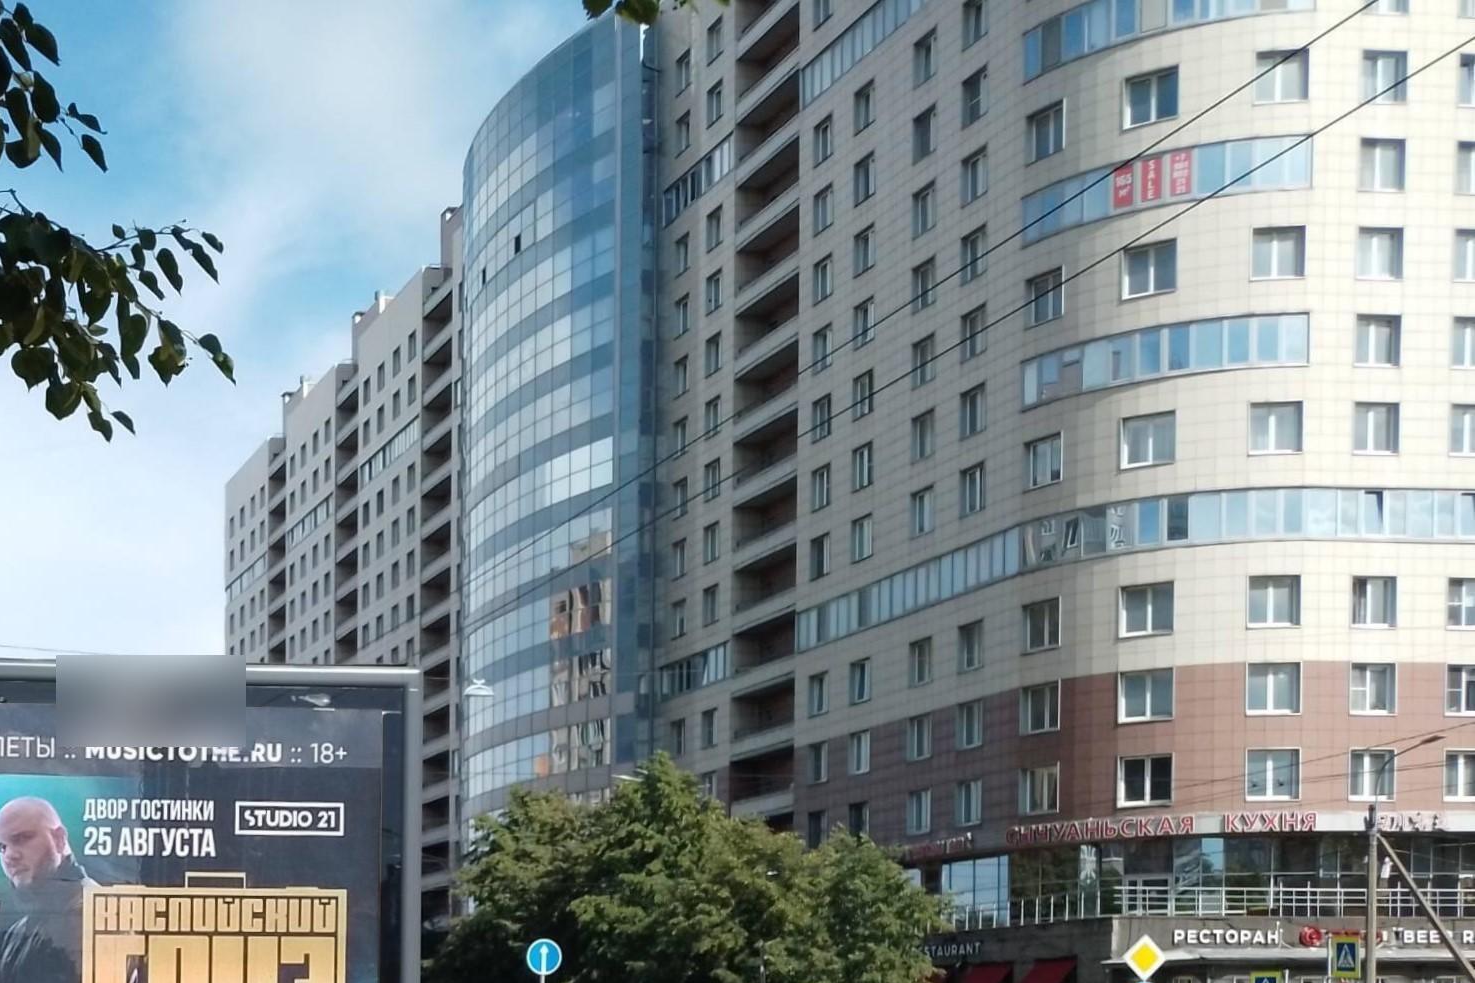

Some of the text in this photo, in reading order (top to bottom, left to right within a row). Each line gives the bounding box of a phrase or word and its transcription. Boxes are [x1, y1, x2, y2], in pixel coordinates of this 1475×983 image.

[310, 743, 347, 764] 18+
[83, 799, 214, 821] ДВОР ГОСТИНКИ
[244, 810, 336, 828] STUDIO 21
[1005, 815, 1196, 847] СЫЧУАНЬСКАЯ
[1224, 812, 1318, 832] КУХНЯ
[83, 827, 216, 857] 25 АВГУСТА
[94, 897, 338, 933] КАСПИЙСКИЙ
[1172, 928, 1280, 945] РЕСТОРАН
